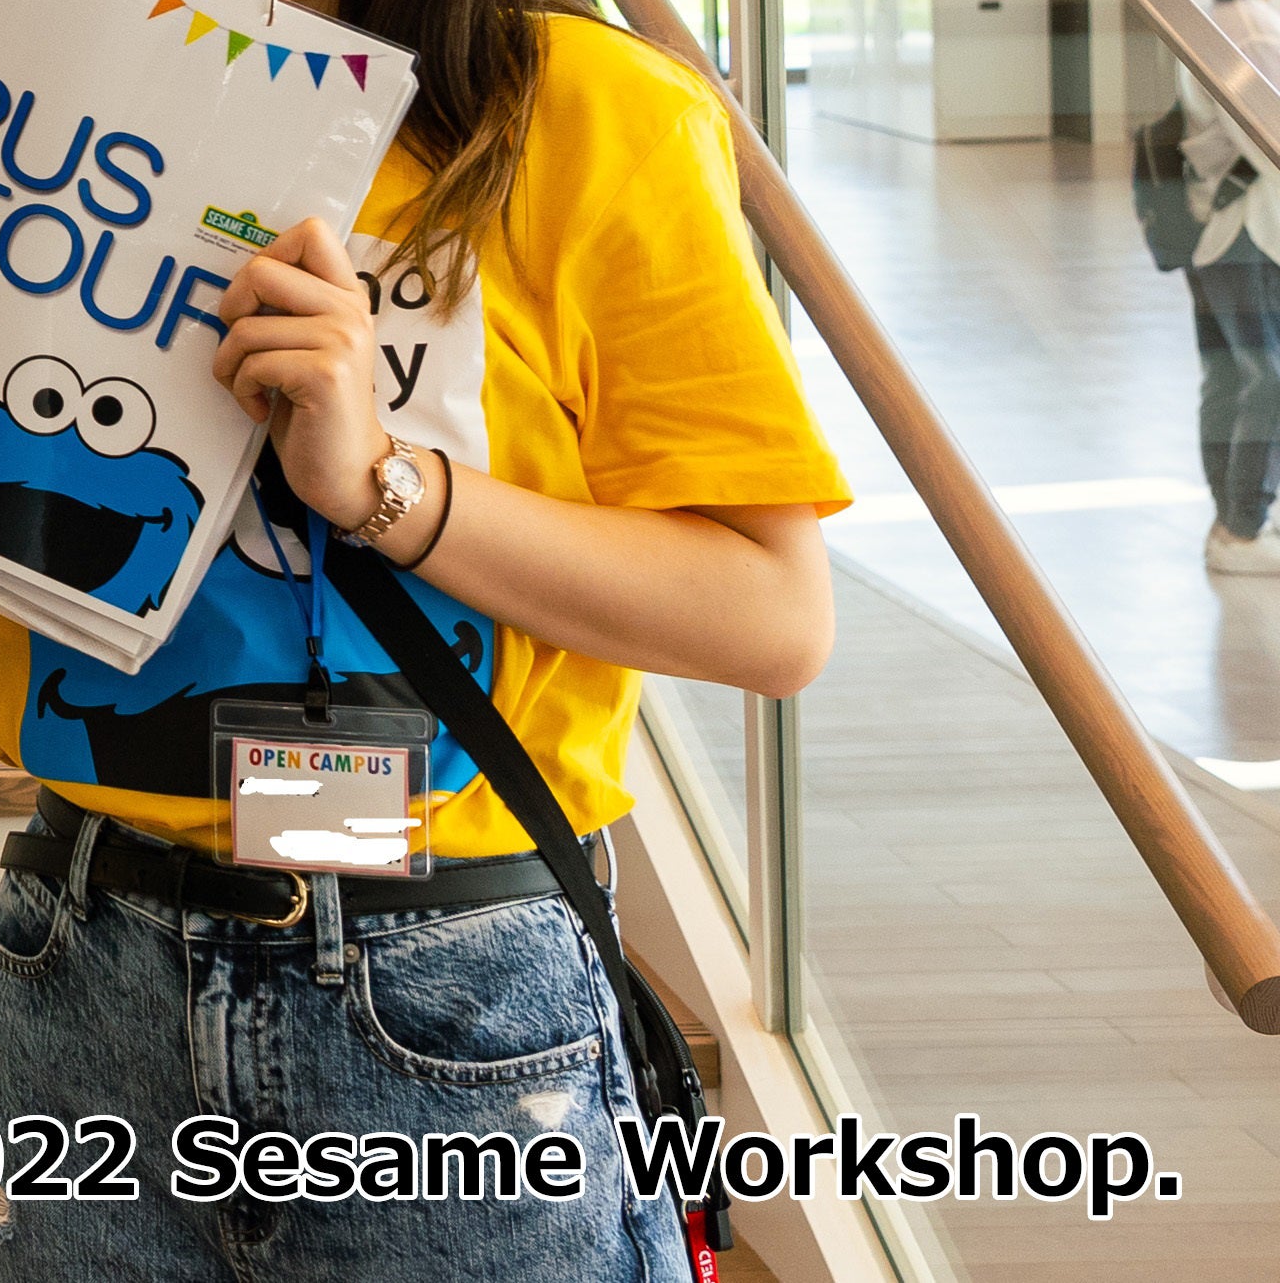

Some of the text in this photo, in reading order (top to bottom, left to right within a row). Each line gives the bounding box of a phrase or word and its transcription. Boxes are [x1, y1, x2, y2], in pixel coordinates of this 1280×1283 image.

[205, 210, 247, 237] SESAME
[244, 225, 277, 247] STREE
[249, 747, 393, 775] OPEN CAMPUS
